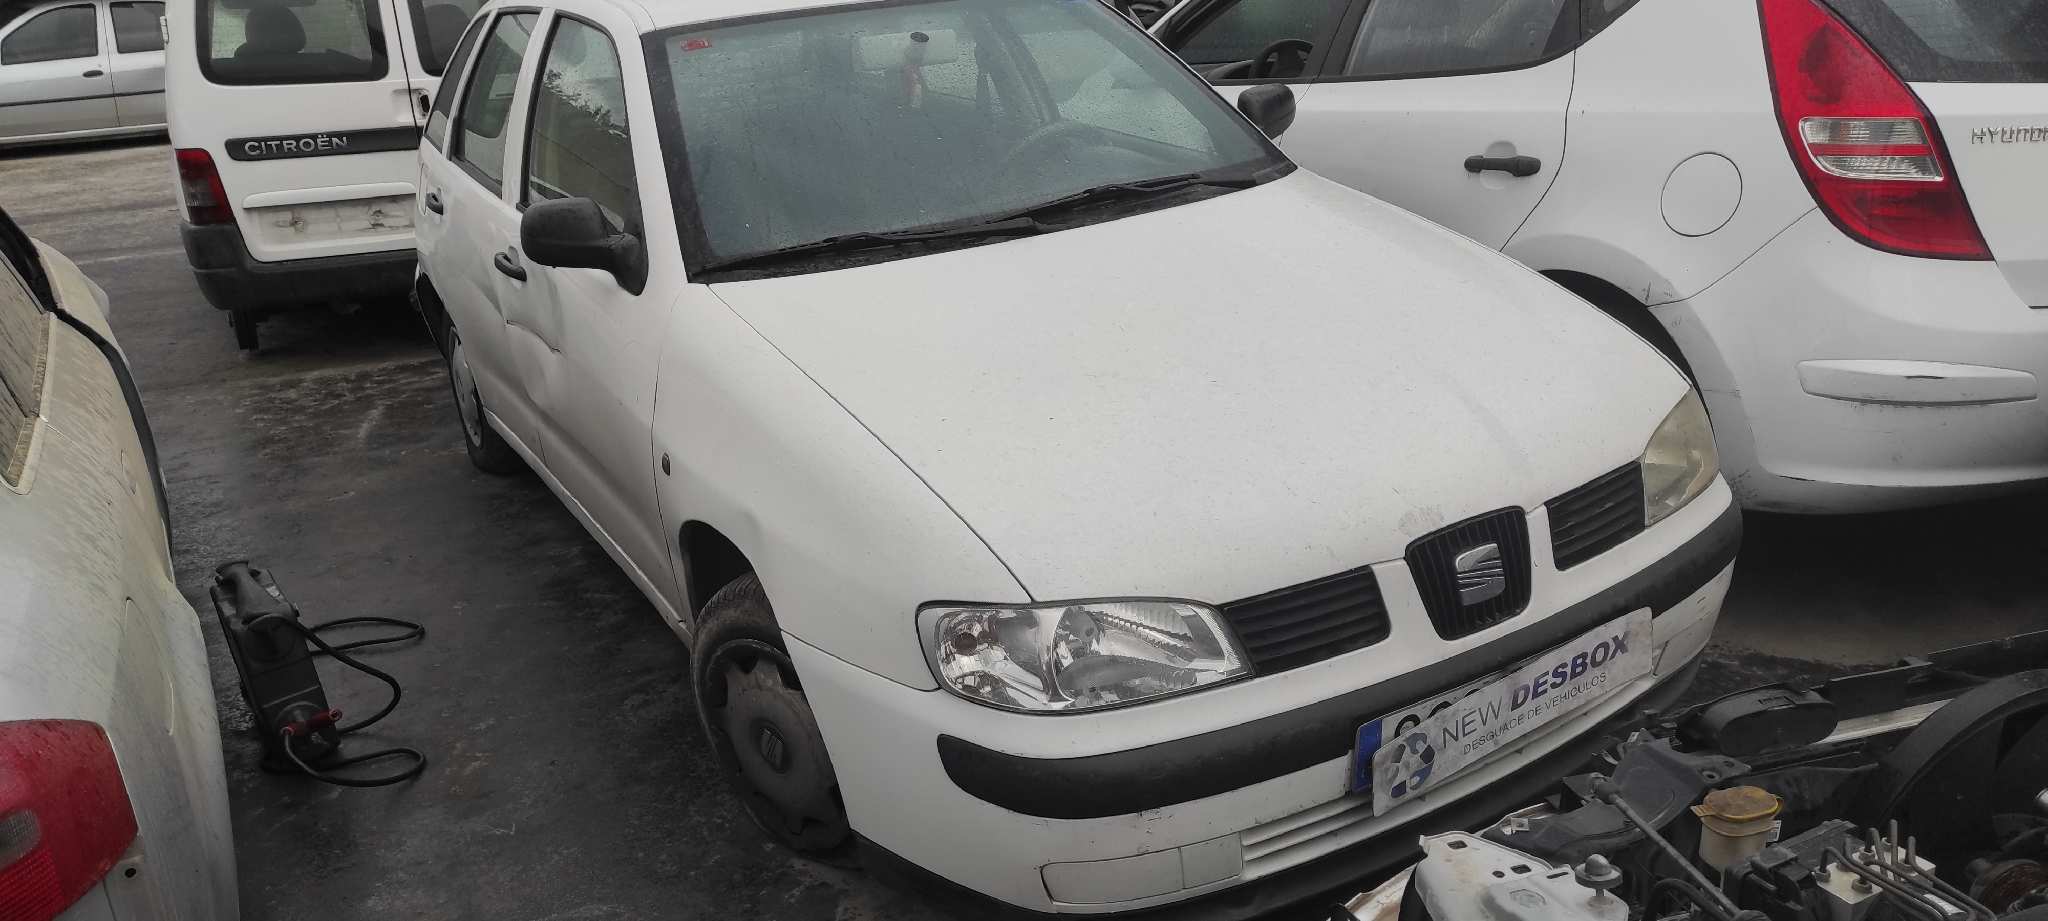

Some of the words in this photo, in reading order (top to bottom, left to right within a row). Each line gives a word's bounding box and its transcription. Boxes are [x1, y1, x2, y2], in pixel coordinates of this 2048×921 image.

[244, 134, 348, 156] CITROËN
[1442, 695, 1503, 750] NEW
[1510, 630, 1631, 713] DESBOX
[1463, 713, 1525, 756] DESGUACE
[1527, 704, 1542, 720] DE
